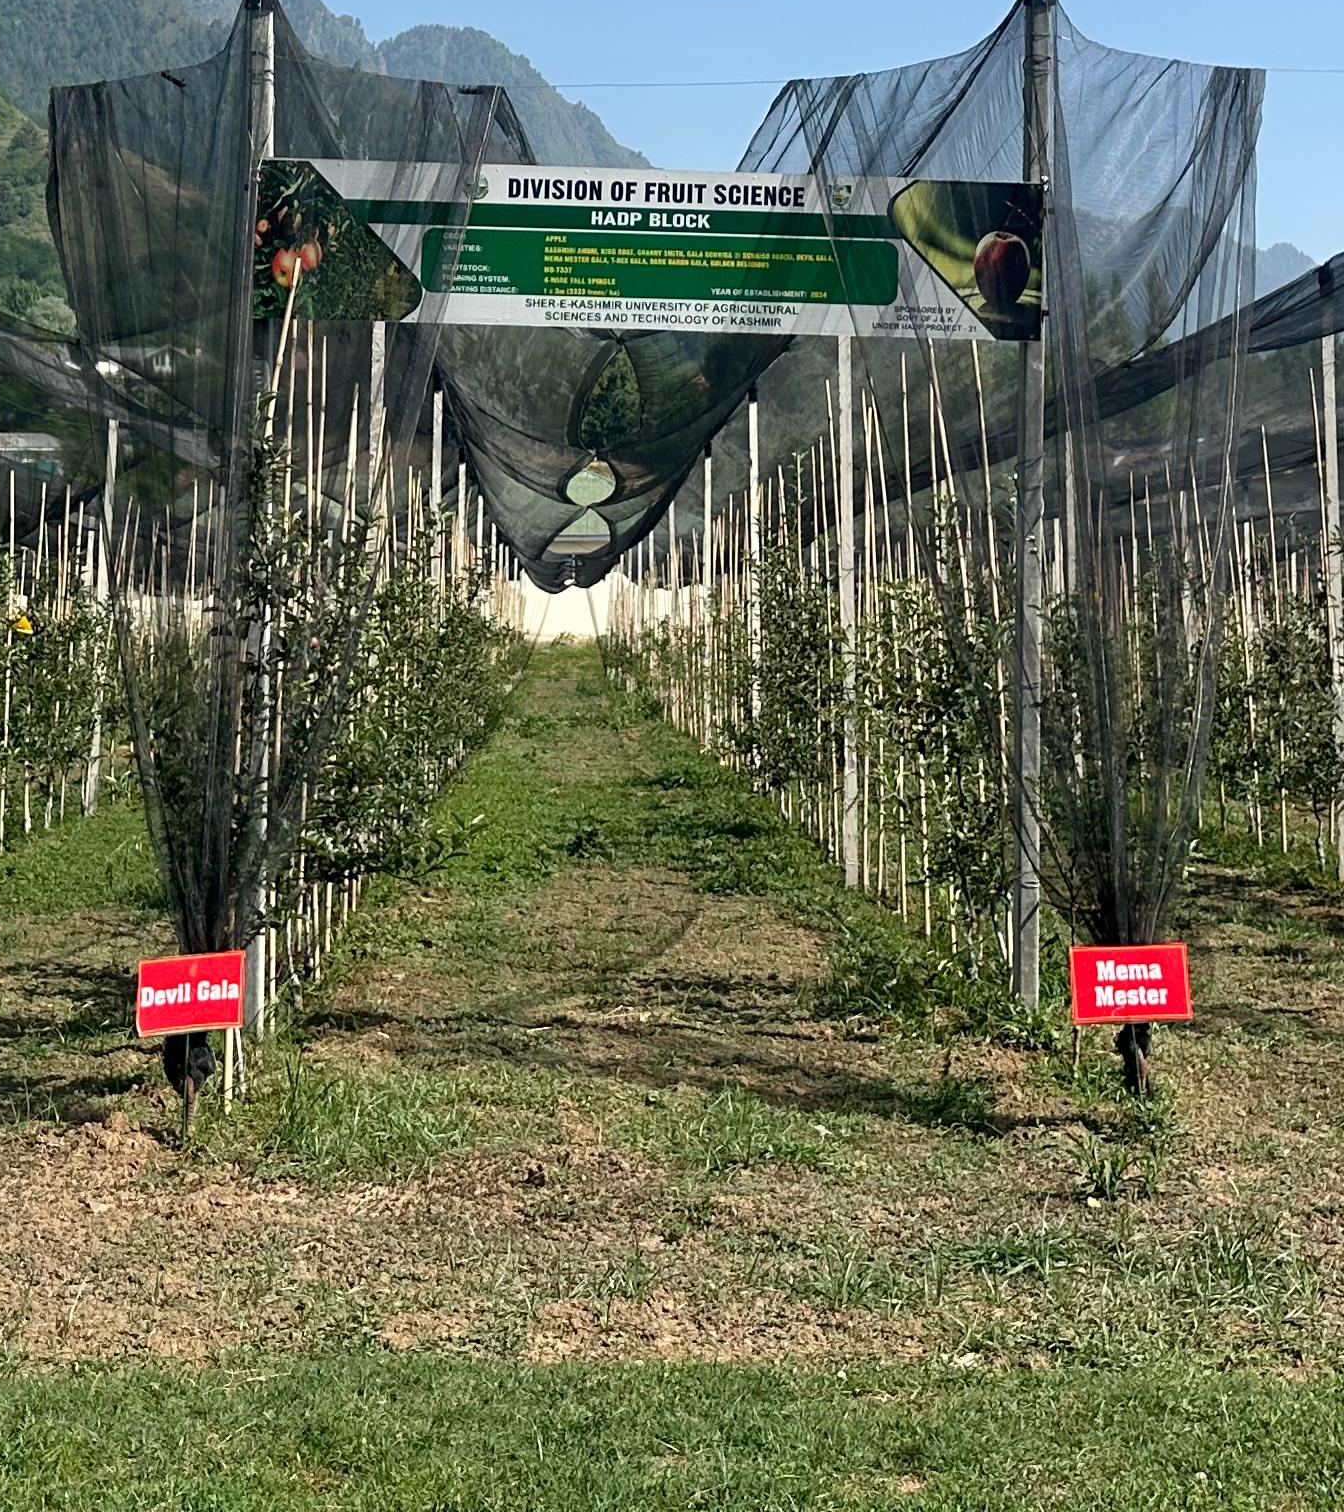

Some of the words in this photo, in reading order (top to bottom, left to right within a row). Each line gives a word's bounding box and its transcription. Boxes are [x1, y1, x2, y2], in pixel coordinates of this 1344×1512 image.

[508, 178, 602, 201] DIVISION
[610, 181, 637, 202] OF
[644, 182, 707, 204] FRUIT
[714, 184, 805, 207] SCIENCE
[591, 210, 642, 227] HADP
[649, 212, 710, 228] BLOCK
[443, 244, 483, 252] VARETIES:
[732, 288, 743, 296] OF
[744, 289, 807, 298] ESTABLISHMENT:
[525, 298, 623, 309] SHER-E-KASHMIR
[626, 301, 692, 312] UNIVERSITY
[694, 303, 709, 312] OF
[712, 304, 798, 315] AGRICULTURAL
[544, 311, 601, 321] SCIENCES
[604, 313, 628, 323] AND
[631, 314, 709, 325] TECHNOLOGY
[712, 316, 728, 325] OF
[730, 316, 782, 327] KASHMIR
[926, 324, 962, 332] PROJECT
[1096, 960, 1162, 981] Mema
[141, 982, 191, 1007] Devil
[197, 979, 239, 1001] Gala
[1094, 986, 1168, 1006] Mester
